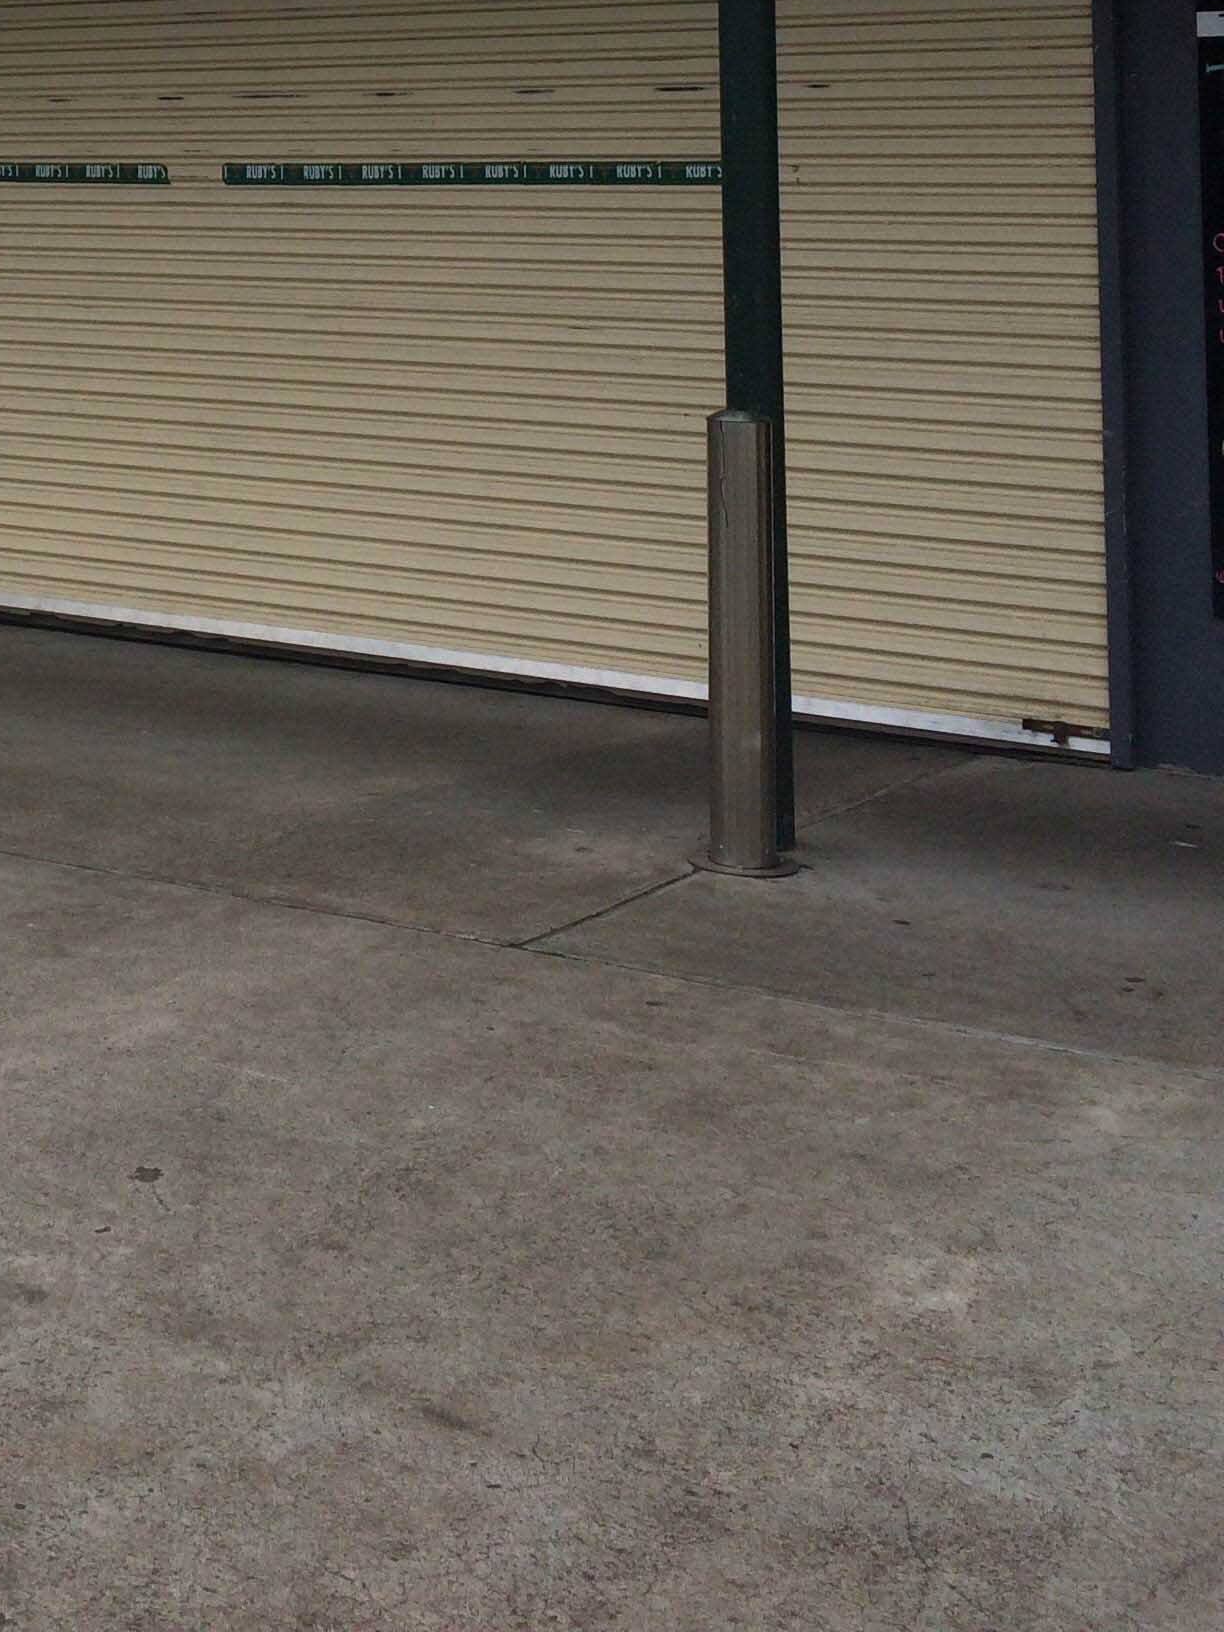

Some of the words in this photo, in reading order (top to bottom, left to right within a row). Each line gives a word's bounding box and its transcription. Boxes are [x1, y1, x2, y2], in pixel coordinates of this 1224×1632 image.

[35, 164, 62, 178] RUBY'S
[86, 164, 113, 179] RUBY'S
[137, 164, 166, 179] RUBY'S
[246, 165, 276, 179] RUBY'S
[303, 165, 334, 180] RUBY'S
[361, 164, 394, 180] RUBY'S
[421, 164, 455, 179] RUBY'S
[484, 164, 519, 179] RUBY'S
[549, 164, 585, 179] RUBY'S
[615, 163, 653, 179] RUBY'S
